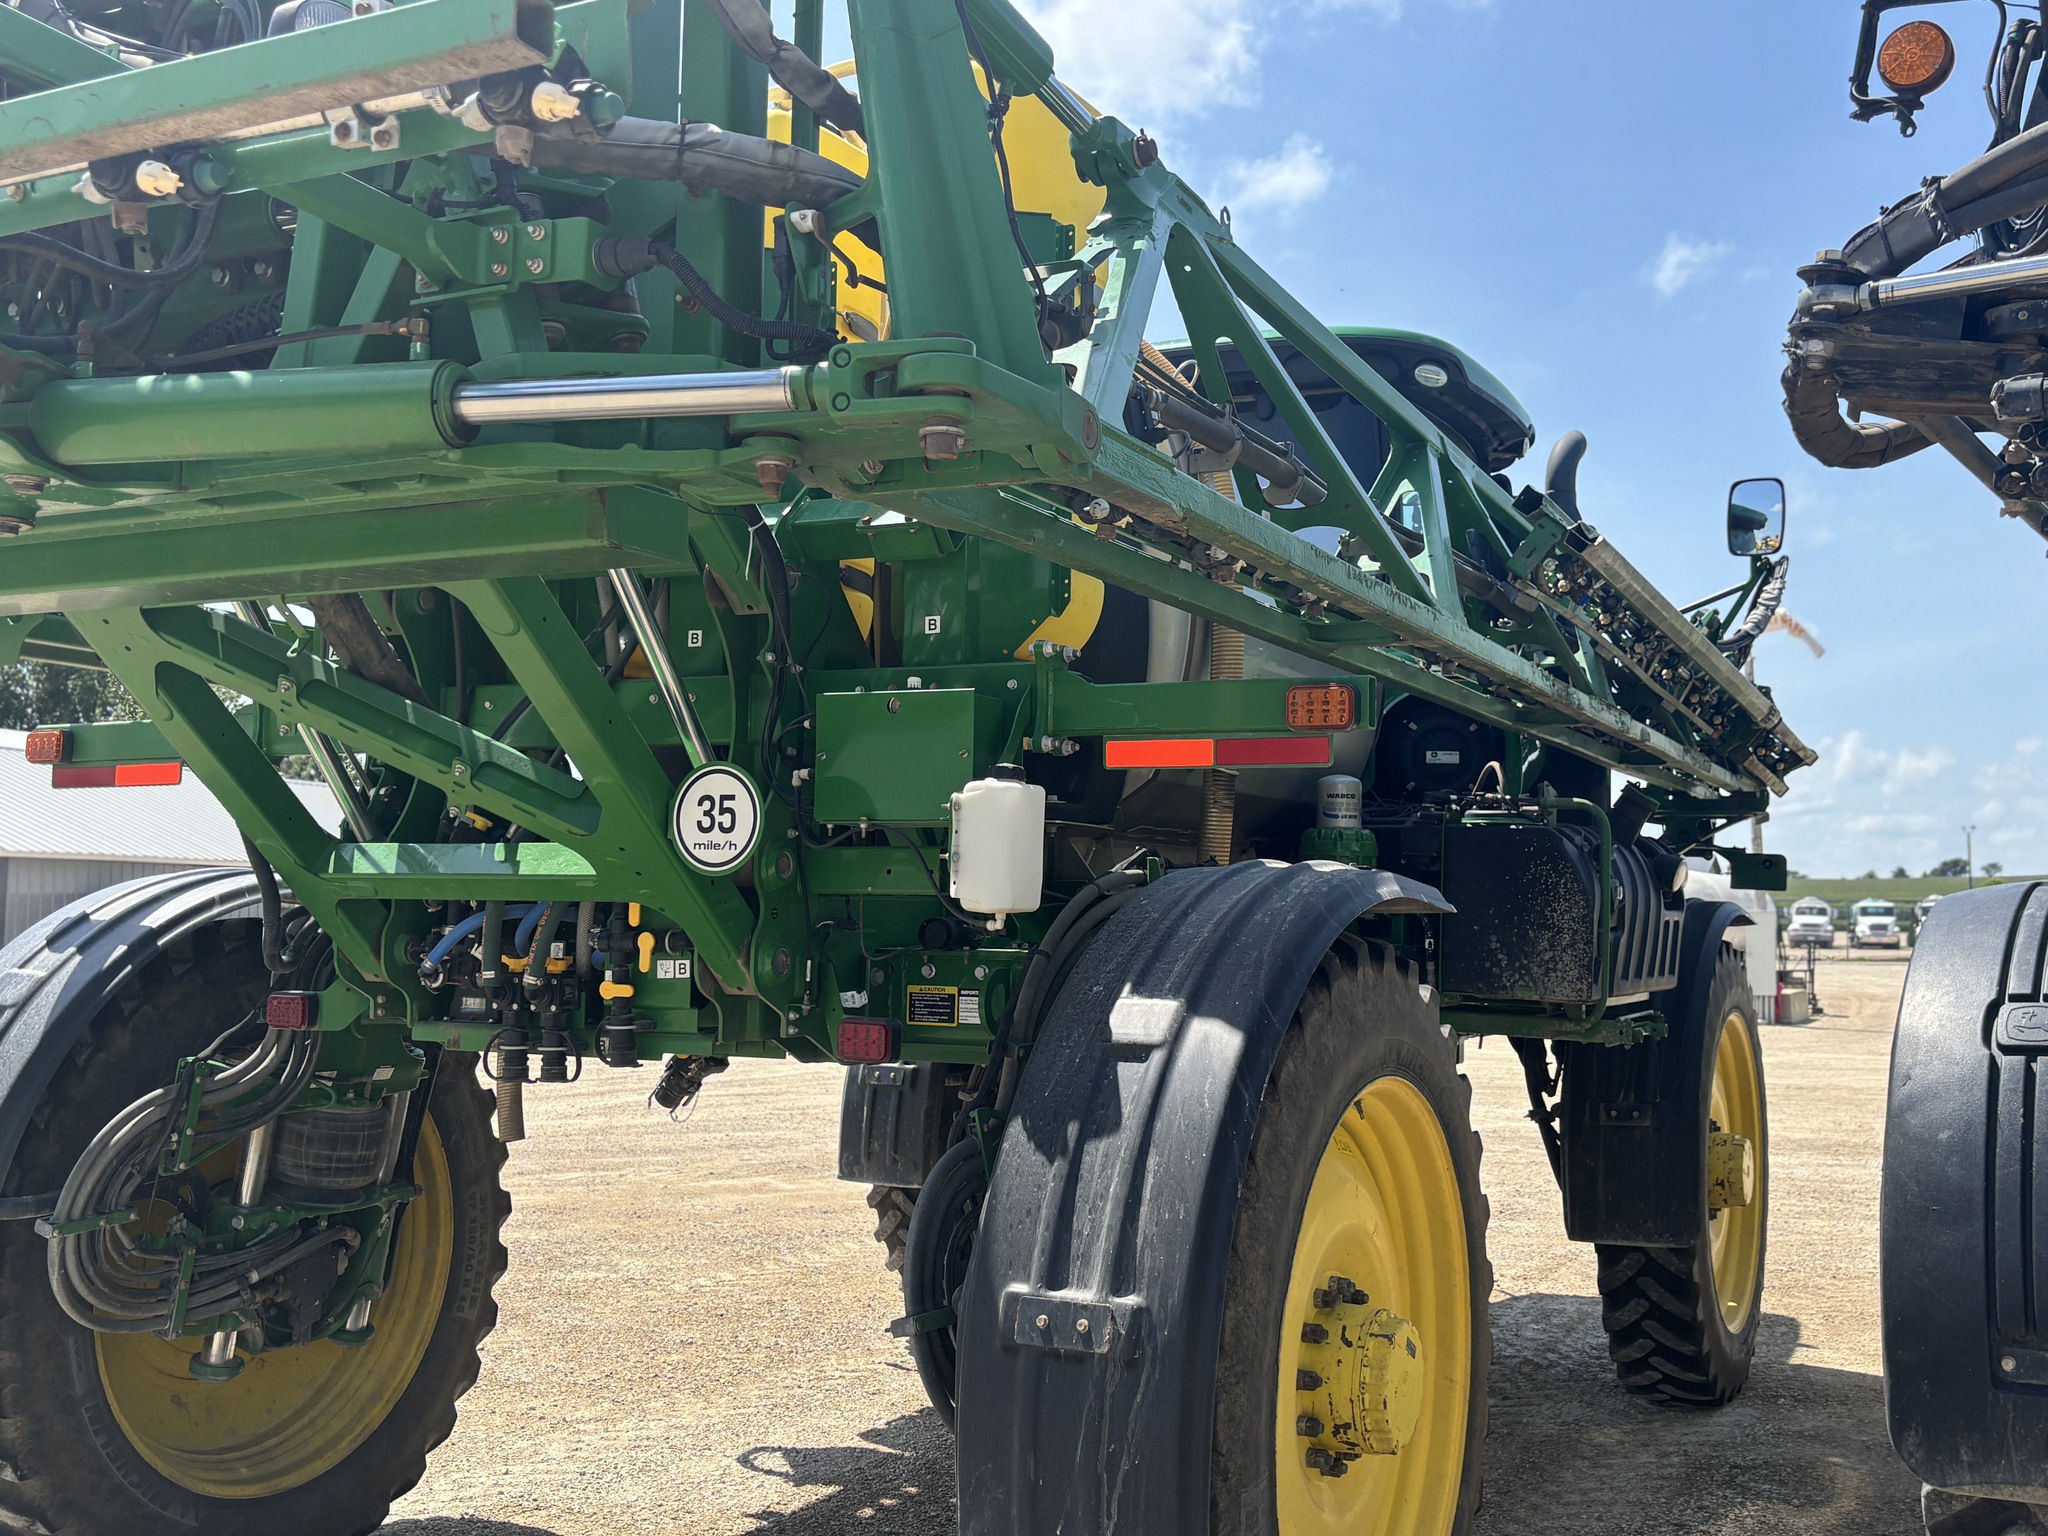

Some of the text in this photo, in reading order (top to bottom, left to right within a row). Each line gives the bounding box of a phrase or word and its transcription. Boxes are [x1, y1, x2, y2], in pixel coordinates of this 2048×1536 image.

[929, 619, 937, 631] B
[691, 633, 699, 644] B
[697, 794, 736, 834] 35
[693, 840, 737, 851] mile/h
[679, 963, 687, 975] B
